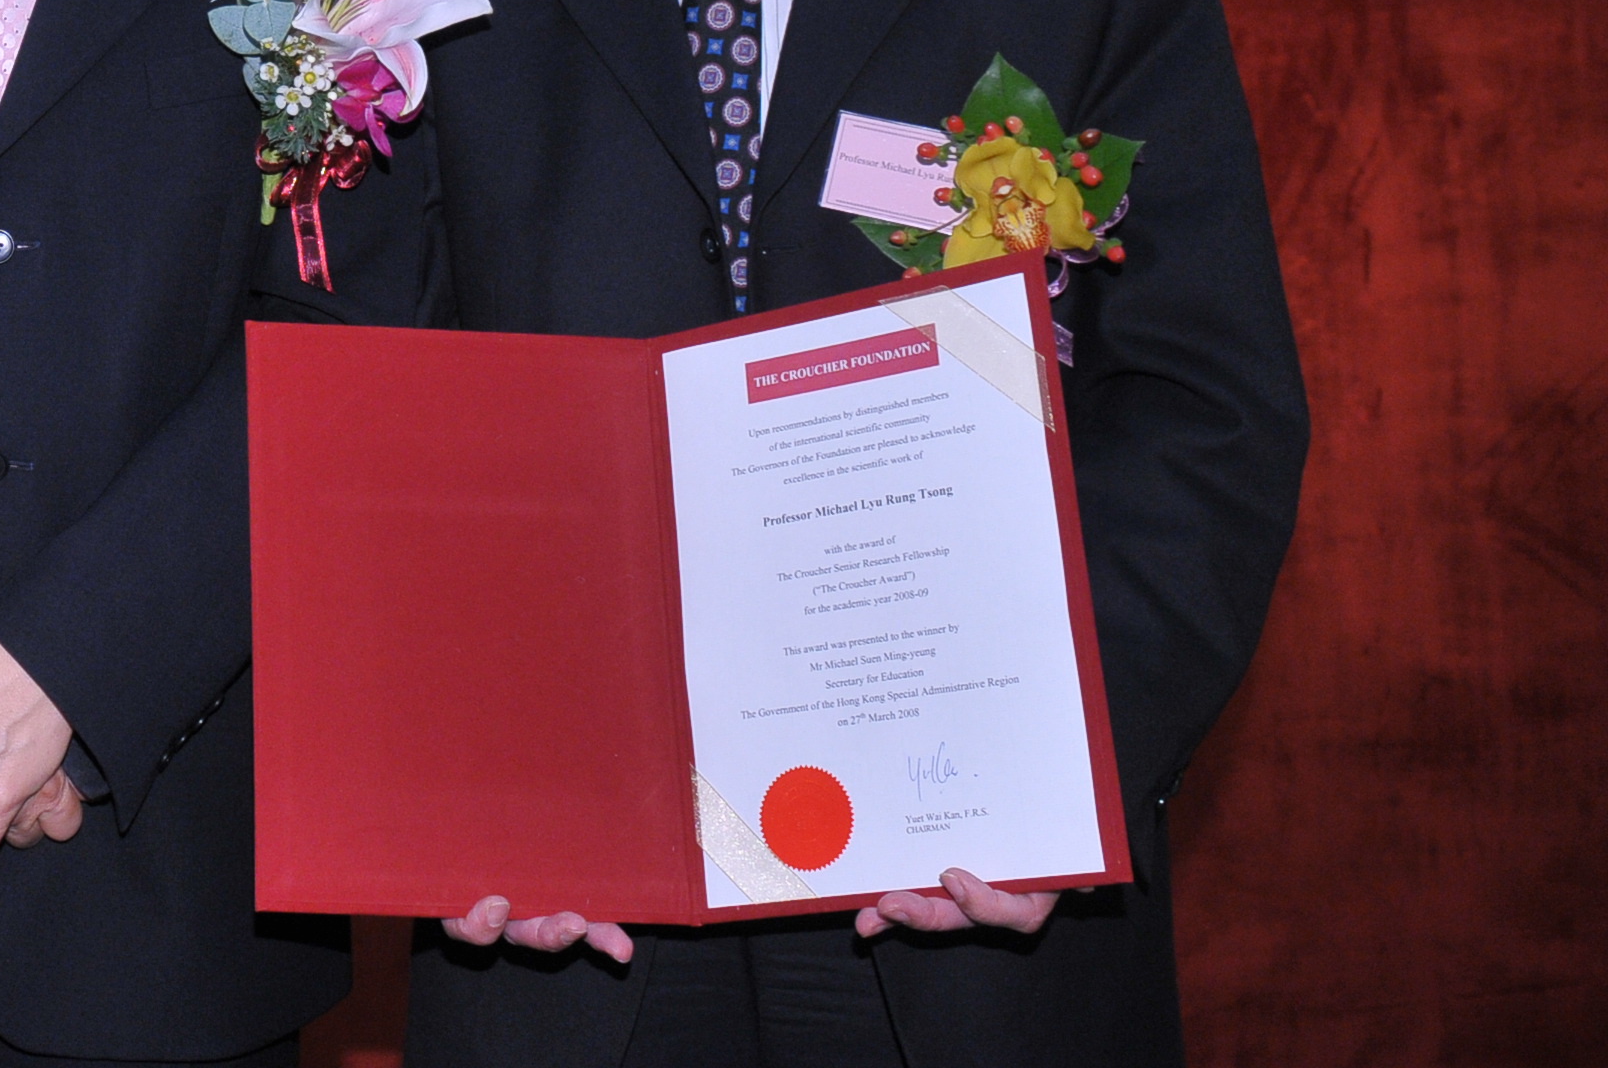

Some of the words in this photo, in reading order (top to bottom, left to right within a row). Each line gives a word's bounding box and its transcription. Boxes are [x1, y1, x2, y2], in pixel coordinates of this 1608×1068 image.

[838, 152, 879, 168] Professor
[881, 160, 916, 176] Michael
[917, 168, 935, 180] Lyu
[754, 373, 779, 387] THE
[780, 359, 849, 382] CROUCHER
[851, 342, 931, 368] FOUNDATION
[748, 428, 771, 439] Upon
[772, 414, 842, 433] recommendations
[843, 411, 853, 421] by
[855, 398, 910, 417] distinguished
[911, 393, 950, 405] members
[769, 442, 778, 452] of
[779, 441, 792, 450] the
[794, 429, 844, 447] international
[845, 422, 882, 437] scientific
[884, 414, 930, 430] community
[763, 512, 811, 527] Professor
[815, 501, 858, 518] Michael
[861, 499, 883, 511] Lyu
[885, 493, 916, 505] Rung
[920, 487, 954, 499] Tsong
[824, 545, 843, 555] with
[844, 543, 857, 552] the
[859, 537, 885, 550] award
[886, 535, 896, 545] of
[777, 573, 793, 582] The
[794, 567, 832, 579] Croucher
[833, 561, 860, 573] Senior
[862, 554, 901, 568] Research
[902, 546, 950, 562] Fellowship
[838, 578, 877, 591] Croucher
[804, 606, 816, 616] for
[818, 604, 831, 613] the
[833, 597, 871, 611] academic
[873, 596, 892, 607] year
[893, 588, 929, 602] 2008-09
[783, 646, 802, 656] This
[803, 641, 829, 654] award
[830, 641, 847, 649] was
[848, 633, 889, 649] presented
[890, 633, 900, 641] to
[901, 630, 915, 640] the
[916, 627, 946, 637] winner
[948, 624, 959, 634] by
[810, 662, 822, 672] Mr
[824, 657, 859, 670] Michael
[860, 655, 882, 665] Suen
[883, 648, 936, 662] Ming-yeung
[825, 678, 864, 690] Secretary
[866, 674, 879, 684] for
[881, 669, 924, 682] Education
[837, 719, 849, 727] on
[868, 711, 896, 723] March
[898, 708, 920, 719] 2008
[905, 815, 924, 824] Yuet
[926, 813, 942, 821] Wai
[906, 823, 951, 835] CHAIRMAN
